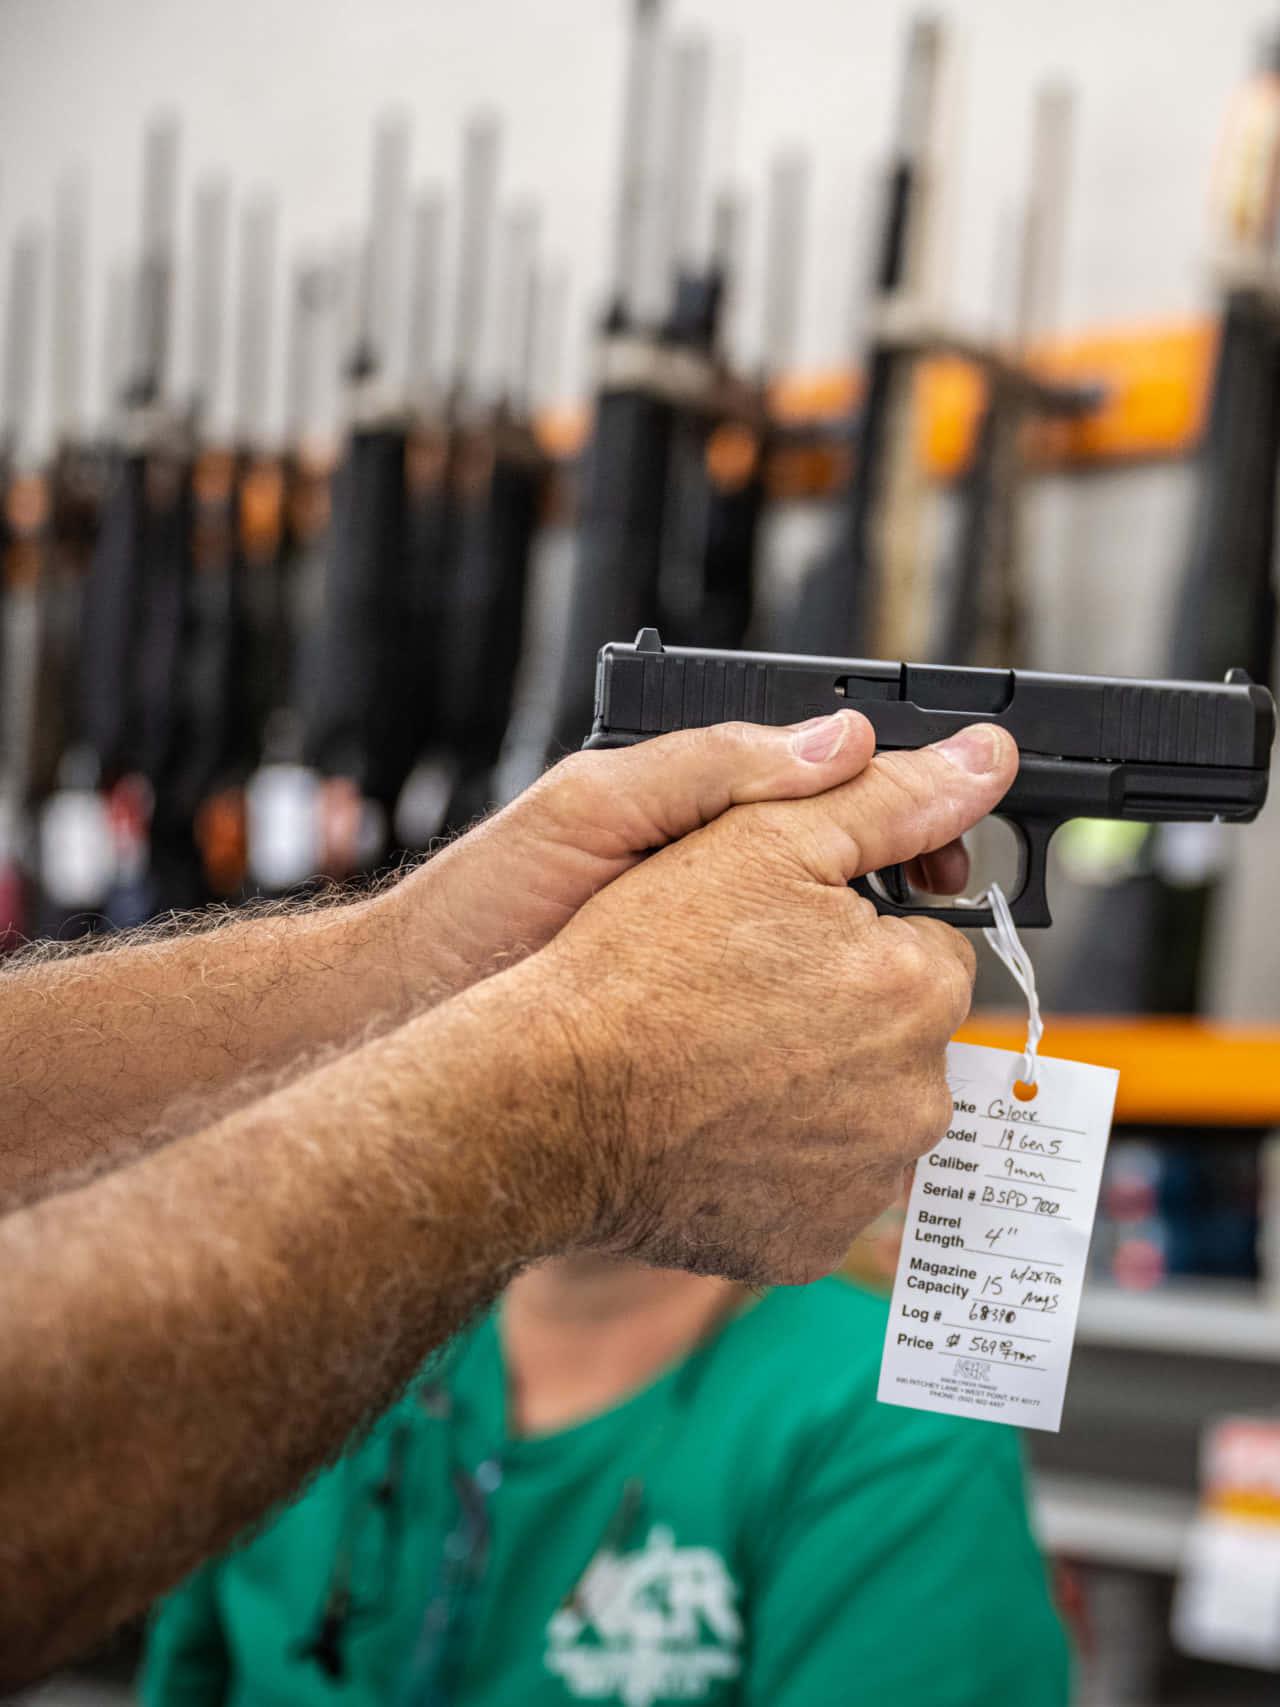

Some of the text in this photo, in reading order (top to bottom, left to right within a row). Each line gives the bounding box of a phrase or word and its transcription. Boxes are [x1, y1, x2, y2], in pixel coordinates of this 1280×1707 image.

[953, 1100, 977, 1114] ake
[946, 1130, 977, 1144] odel
[999, 1128, 1014, 1151] 19
[928, 1153, 979, 1174] Caliber
[1004, 1157, 1046, 1182] 9mm
[922, 1181, 976, 1201] Serial #
[918, 1210, 962, 1230] Barrel
[914, 1228, 965, 1249] Length
[909, 1256, 977, 1281] Magazine
[906, 1275, 970, 1300] Capacity
[980, 1274, 1003, 1296] 15
[901, 1303, 942, 1323] Log #
[896, 1333, 934, 1350] Price
